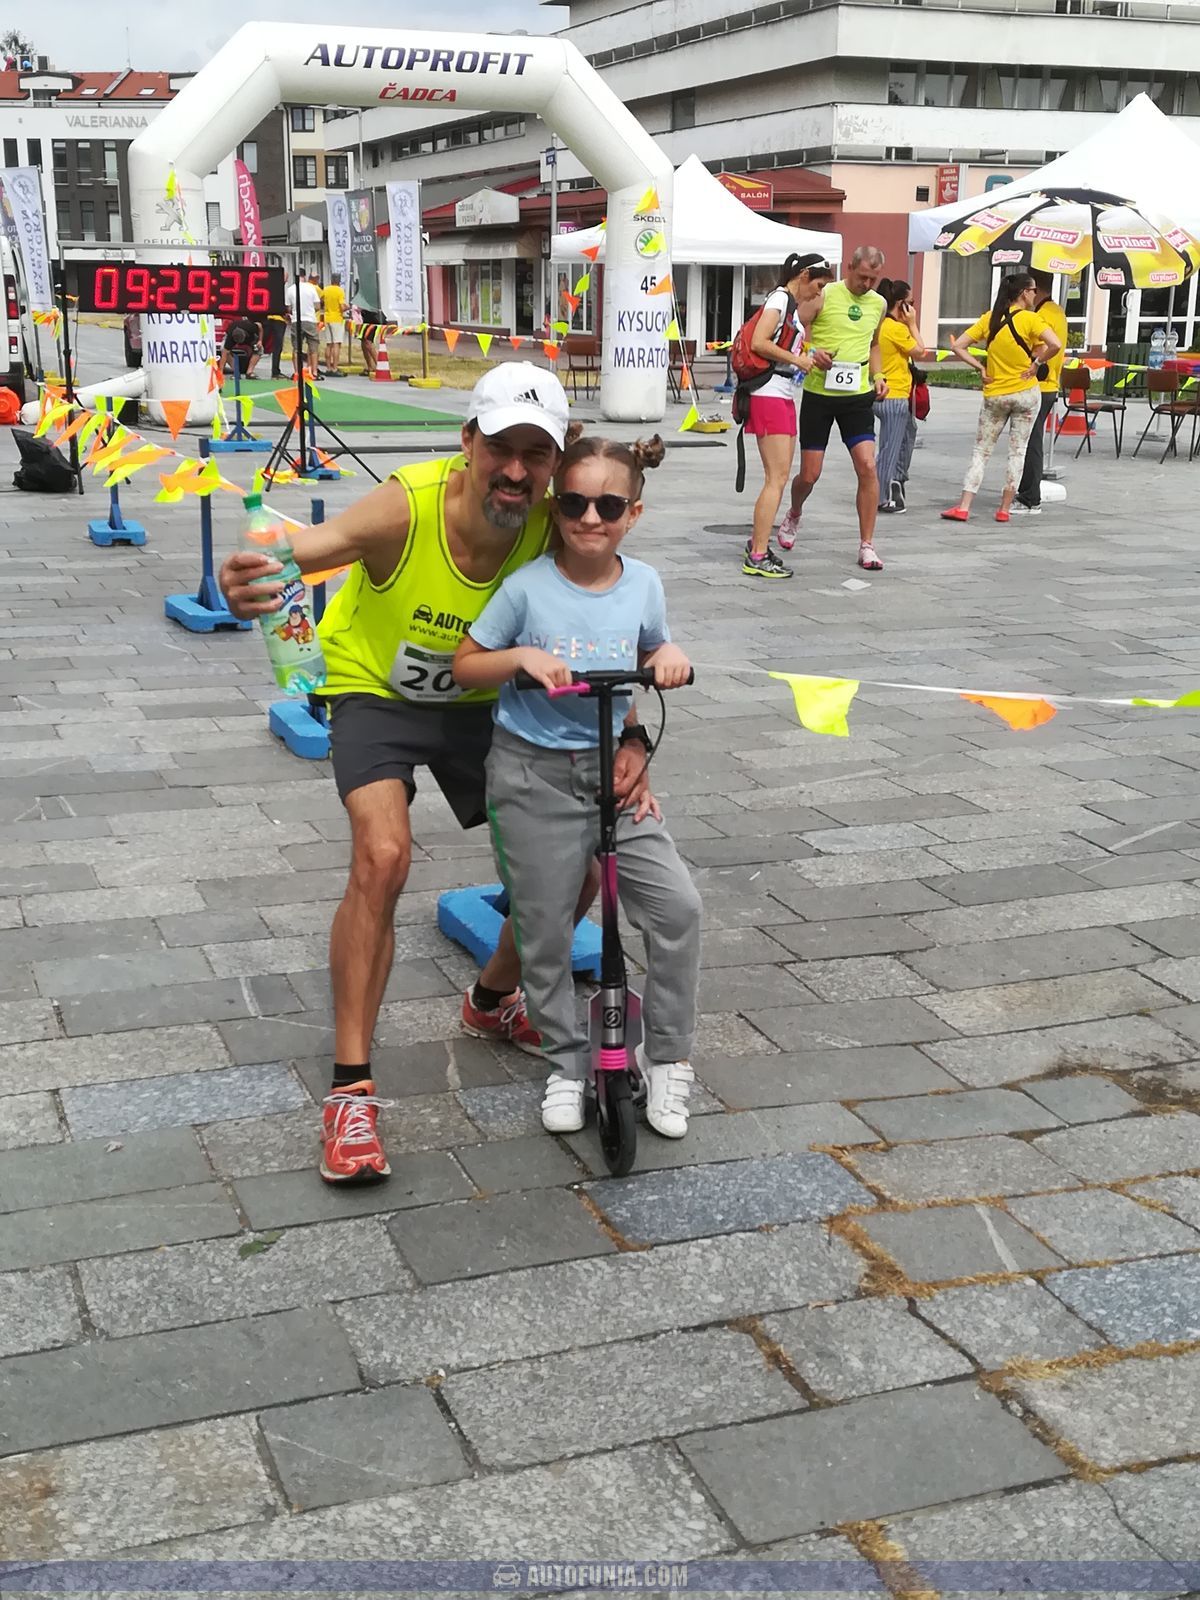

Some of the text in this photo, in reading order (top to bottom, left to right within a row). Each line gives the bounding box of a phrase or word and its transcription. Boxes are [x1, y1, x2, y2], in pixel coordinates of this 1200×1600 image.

[303, 43, 534, 76] AUTOPROFIT
[378, 82, 457, 102] ČADCA
[65, 115, 149, 128] VALERIANNA
[1022, 225, 1078, 244] Urpiner
[1104, 235, 1153, 248] Urpiner
[94, 267, 271, 312] 09:29:36
[617, 310, 669, 332] KYSUCK
[613, 343, 667, 368] MARATÓ
[835, 371, 853, 385] 65
[434, 612, 472, 634] AUTO
[529, 631, 634, 660] WEEKEN
[400, 665, 465, 692] 20
